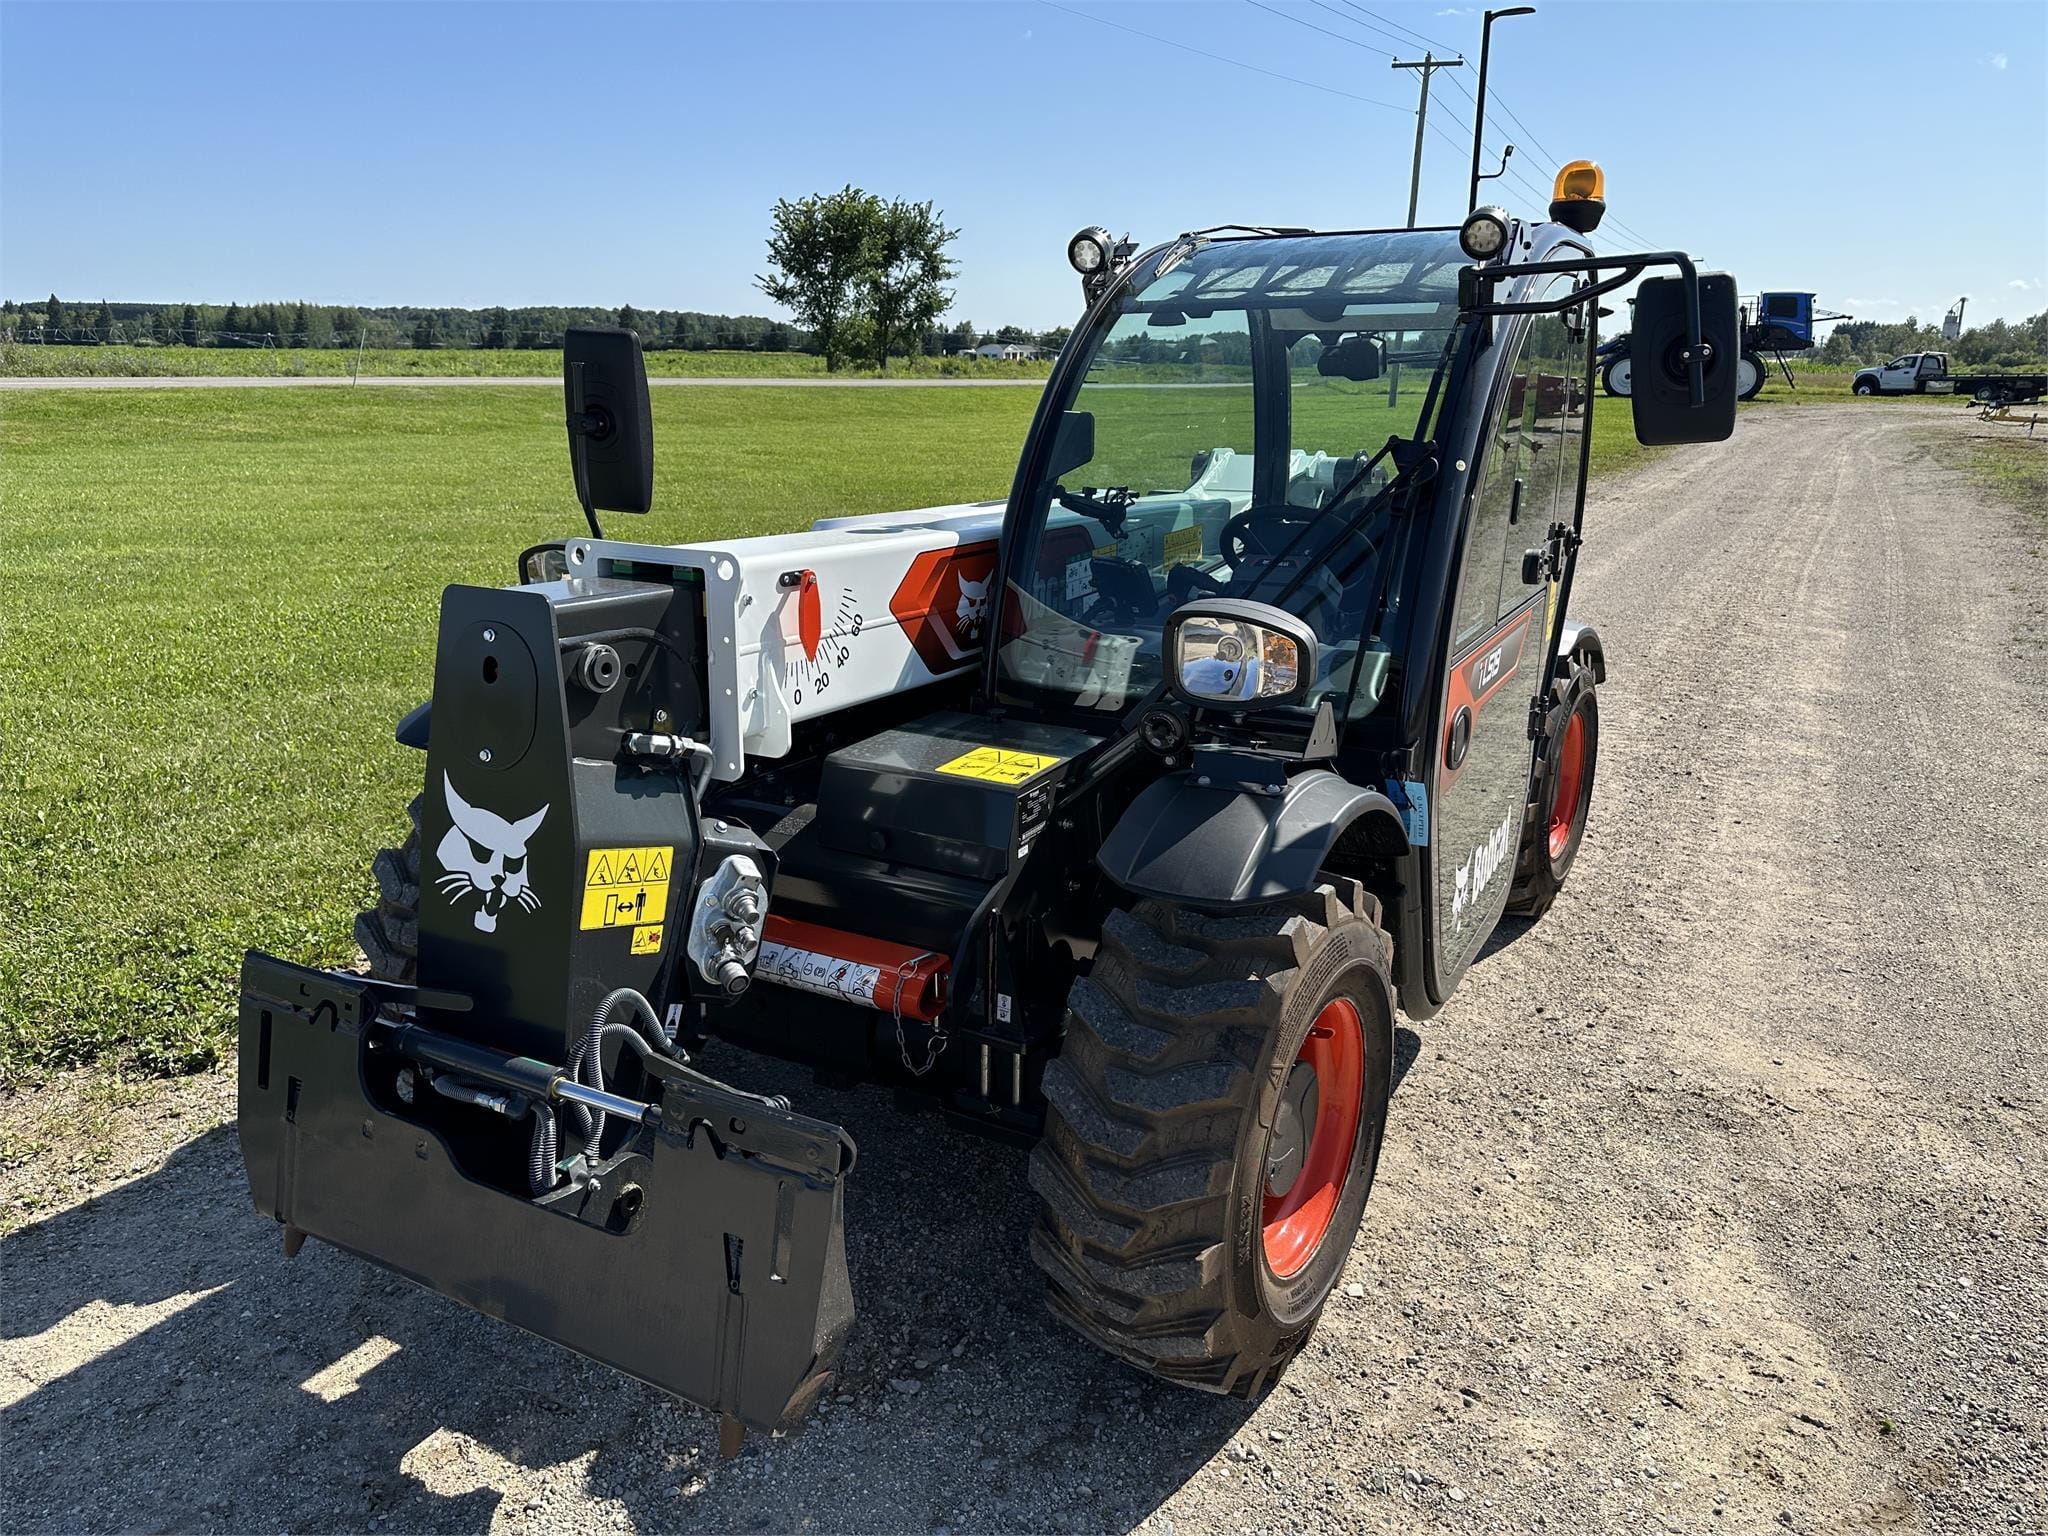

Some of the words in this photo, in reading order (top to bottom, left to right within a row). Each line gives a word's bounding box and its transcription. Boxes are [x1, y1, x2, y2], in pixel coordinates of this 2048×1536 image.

[852, 614, 863, 636] 60
[837, 646, 850, 668] 40
[814, 672, 830, 695] 20
[794, 689, 802, 706] 0
